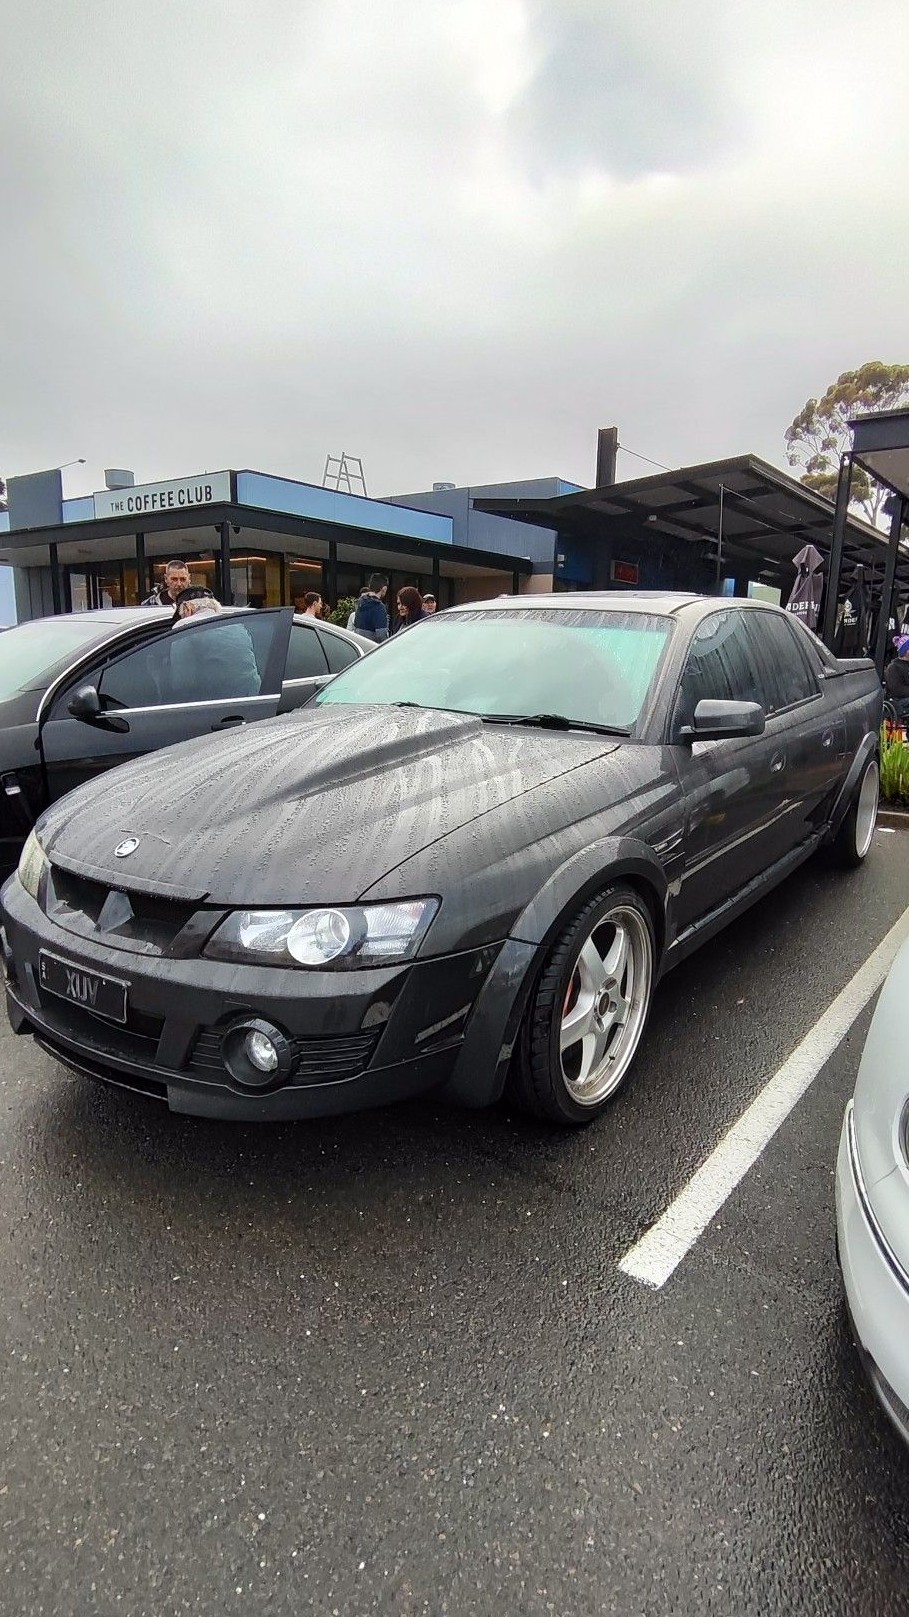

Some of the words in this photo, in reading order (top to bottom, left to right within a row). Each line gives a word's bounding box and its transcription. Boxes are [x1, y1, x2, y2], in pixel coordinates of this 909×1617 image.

[110, 501, 124, 513] THE
[127, 491, 174, 512] COFFEE
[177, 485, 212, 505] CLUB
[66, 969, 99, 1006] XUV
